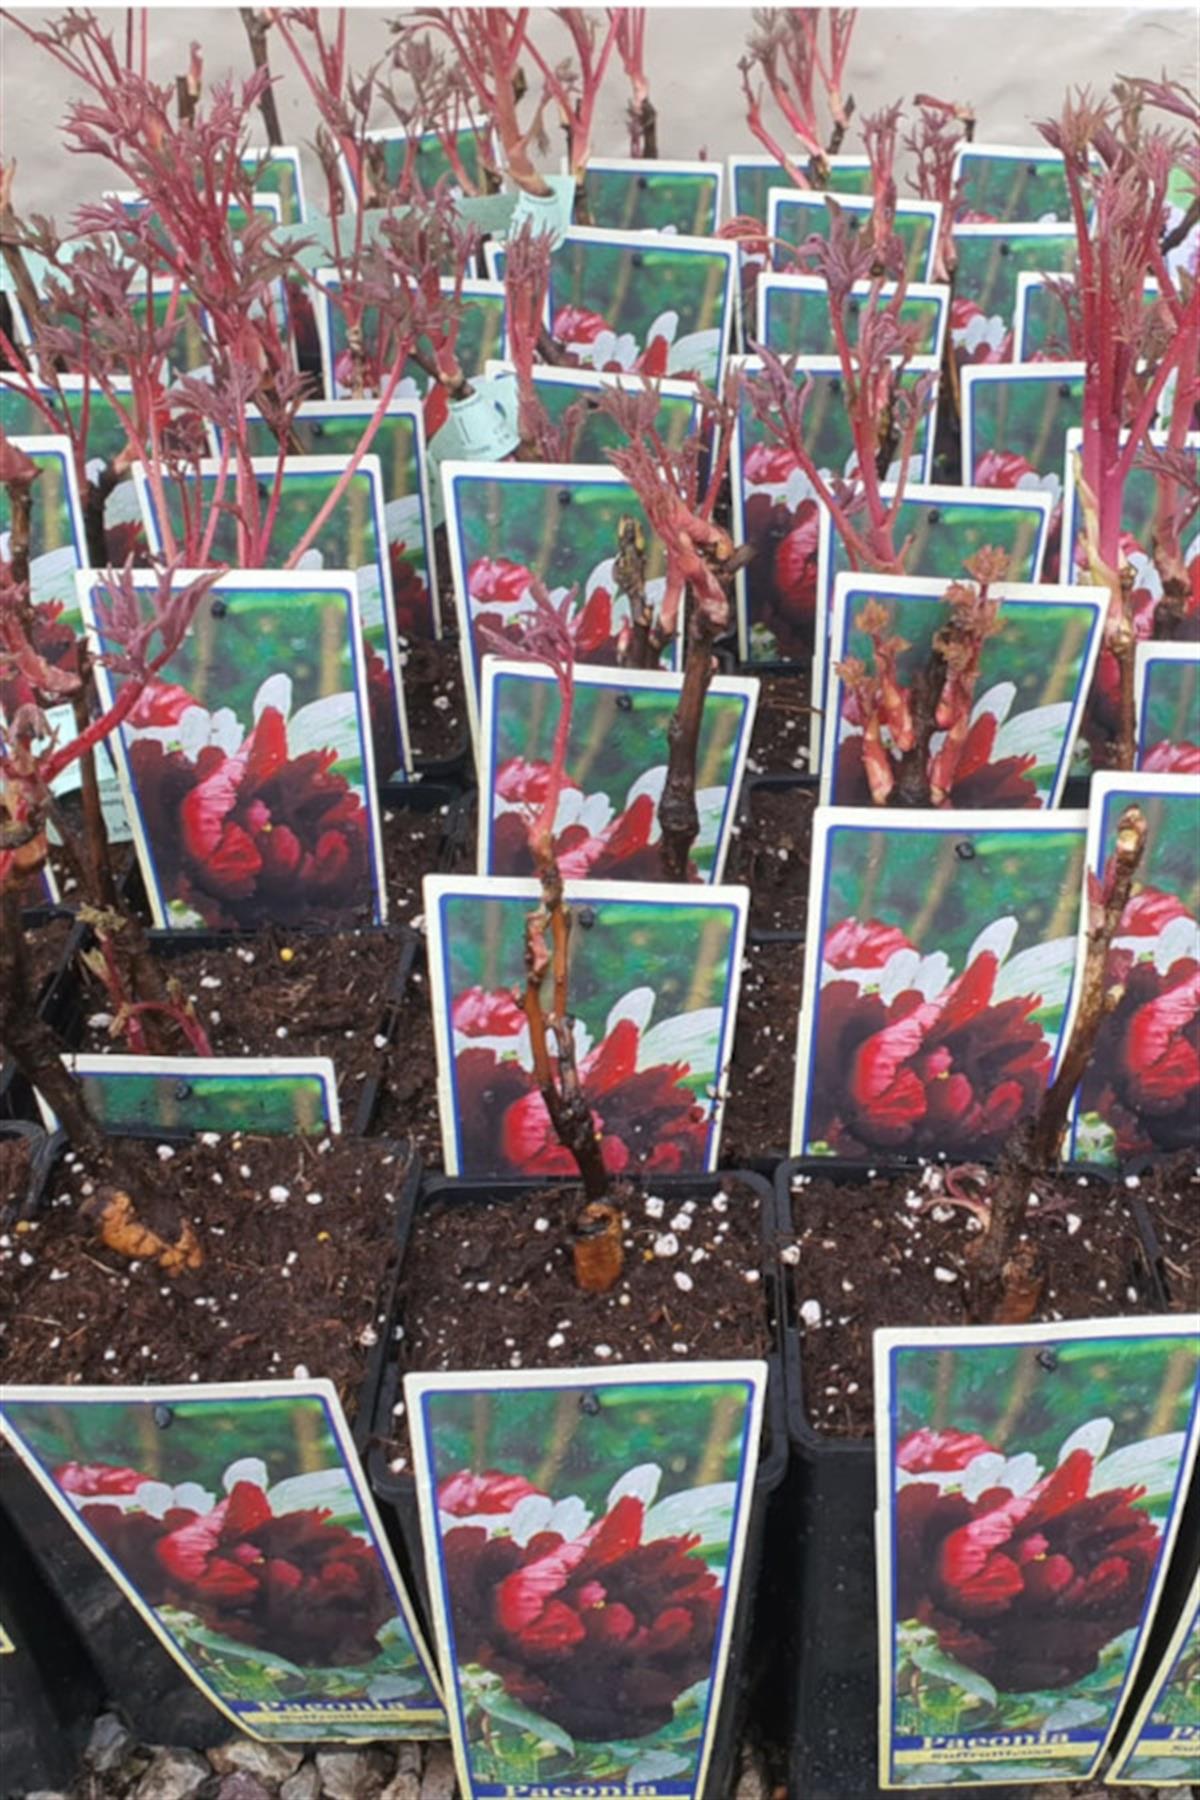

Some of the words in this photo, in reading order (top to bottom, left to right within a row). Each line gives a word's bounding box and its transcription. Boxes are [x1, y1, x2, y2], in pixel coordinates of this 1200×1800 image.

[258, 1701, 406, 1712] Paeonia
[922, 1731, 1069, 1749] Paeonia
[503, 1781, 657, 1798] Paeonia
